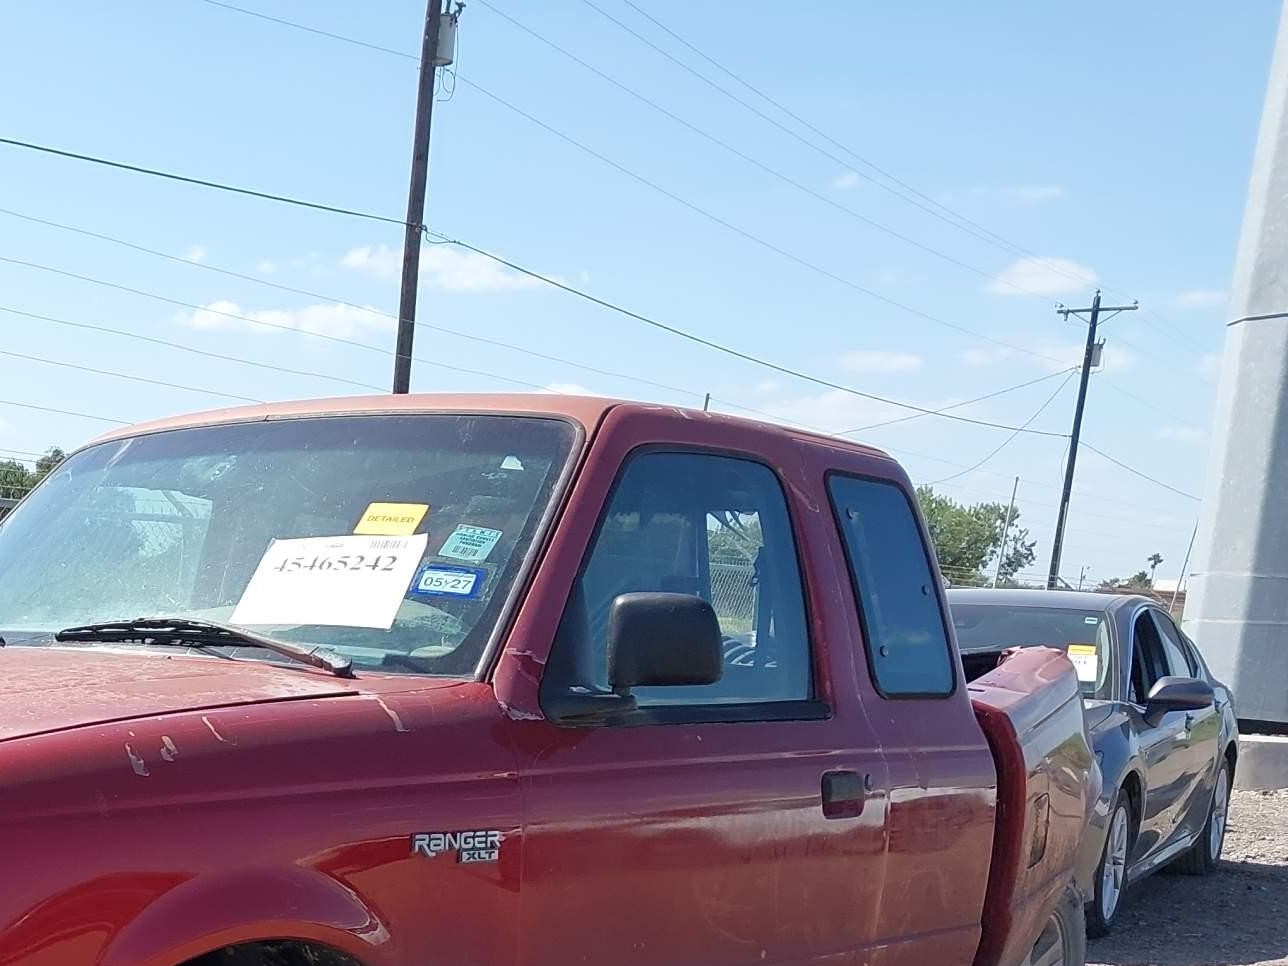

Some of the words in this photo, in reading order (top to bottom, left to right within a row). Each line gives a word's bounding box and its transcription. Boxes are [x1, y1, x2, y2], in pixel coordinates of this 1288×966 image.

[367, 515, 415, 523] DETAILED
[273, 555, 398, 572] 45465242
[414, 831, 502, 857] RANGER
[465, 850, 495, 861] XLT
